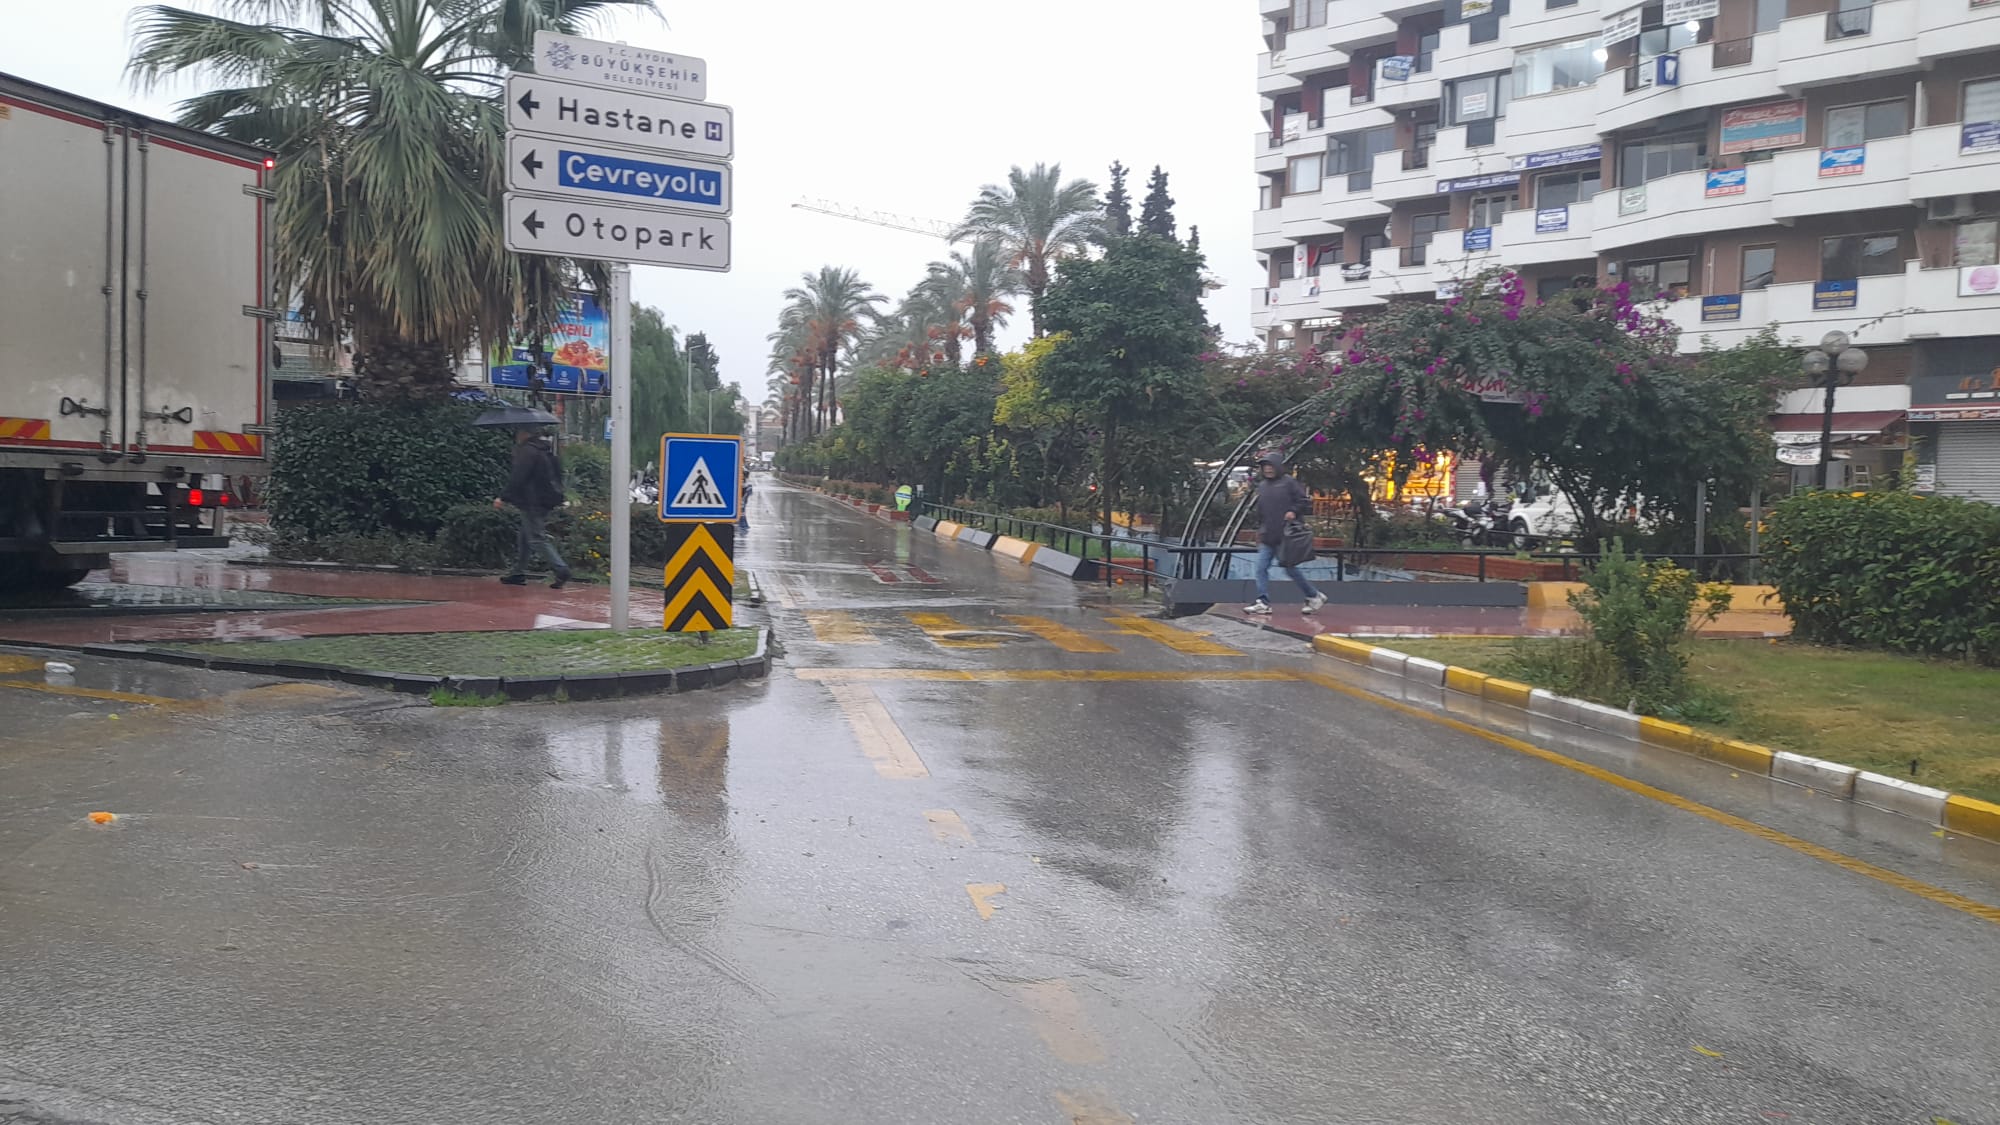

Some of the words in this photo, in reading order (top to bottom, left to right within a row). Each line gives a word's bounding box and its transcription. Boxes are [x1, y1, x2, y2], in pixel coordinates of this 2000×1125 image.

[581, 54, 699, 83] BÜYÜKŞEHİR
[608, 47, 632, 58] T.C.
[636, 53, 674, 64] AYDIN
[604, 73, 678, 91] BELEDİYESİ
[558, 97, 696, 139] Hastane
[566, 155, 716, 197] Çevreyolu
[565, 212, 714, 250] Otopark
